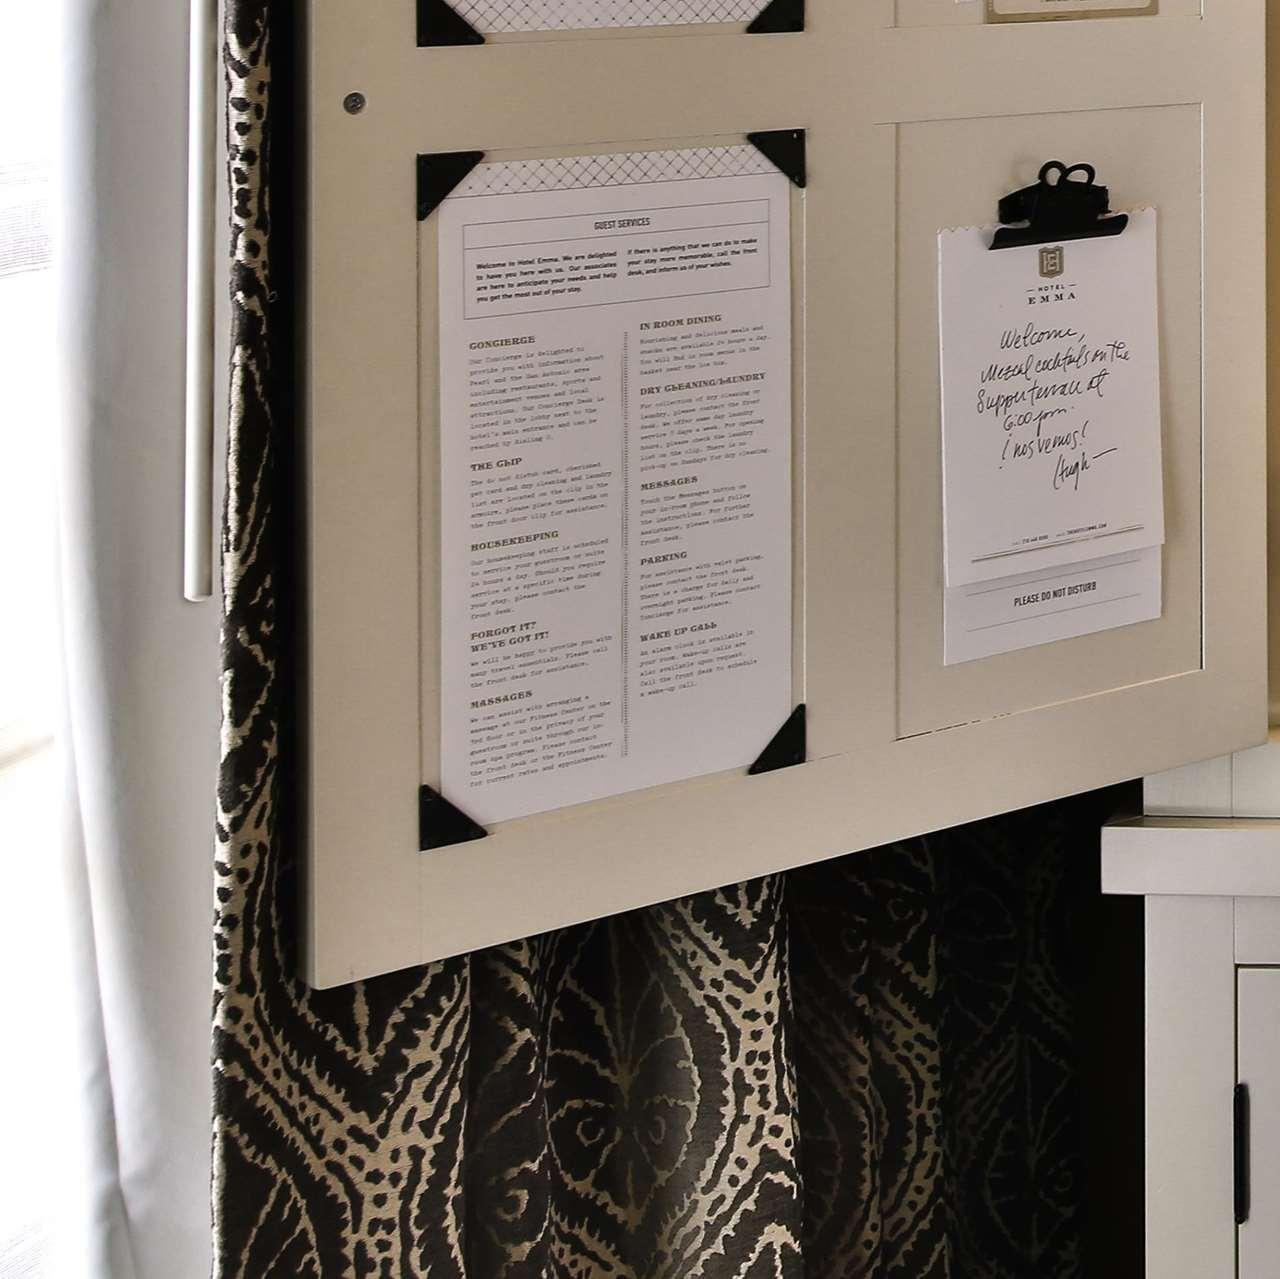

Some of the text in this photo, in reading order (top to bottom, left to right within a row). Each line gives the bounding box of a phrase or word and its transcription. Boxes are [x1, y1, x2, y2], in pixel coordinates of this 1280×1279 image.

[594, 217, 650, 231] GUEST SERVICES
[1038, 284, 1065, 292] HOTEL
[1027, 291, 1076, 305] EMMA
[640, 314, 722, 331] IN ROOM DINING
[469, 335, 536, 351] CONCIERGE
[1000, 322, 1085, 350] Welcome,
[640, 386, 661, 396] DRY
[470, 457, 523, 472] THE CLIP
[640, 476, 699, 491] MESSAGES
[470, 530, 559, 552] HOUSEKEEPING
[640, 551, 688, 566] PARKING
[1014, 581, 1097, 607] PLEASE DO NOT DISTURB
[470, 621, 537, 641] FORGOT IT?
[640, 629, 671, 643] WAKE
[674, 627, 688, 637] UP
[470, 631, 550, 653] WE'VE GOT IT!
[470, 690, 533, 710] MASSAGES
